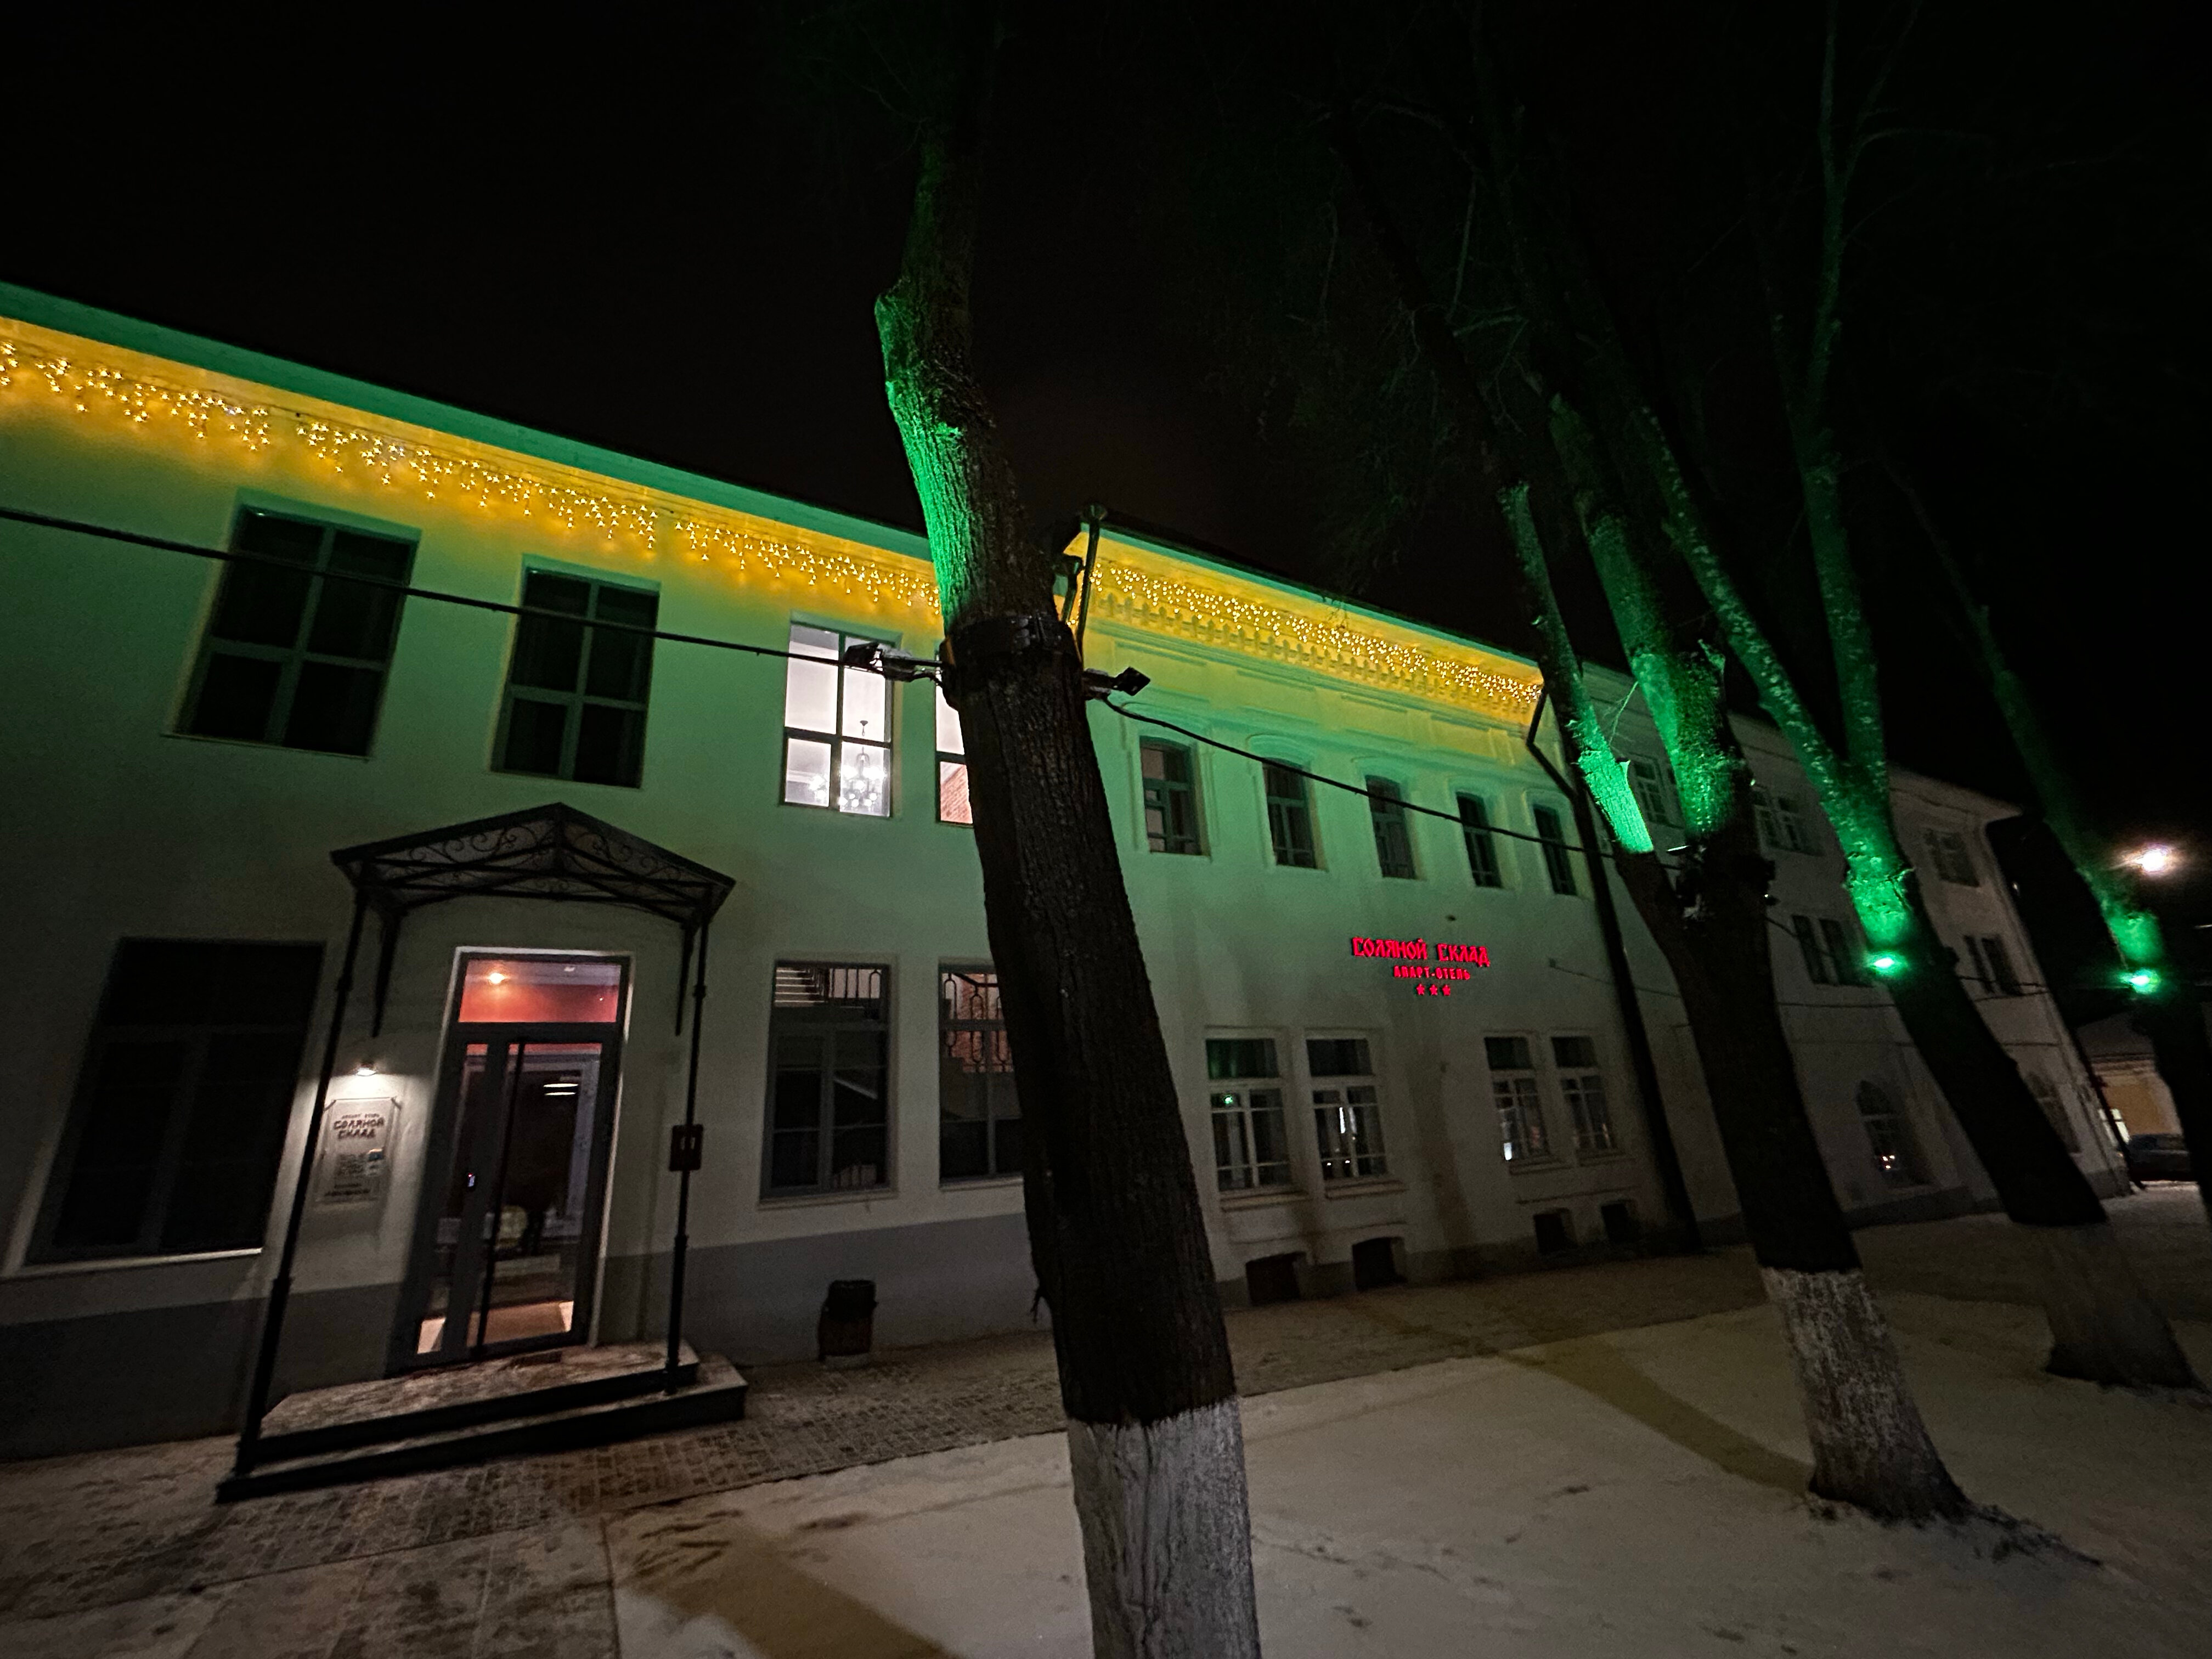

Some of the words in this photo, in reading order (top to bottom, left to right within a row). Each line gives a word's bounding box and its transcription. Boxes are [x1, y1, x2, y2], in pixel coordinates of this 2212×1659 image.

[1352, 936, 1427, 960] СОЛЯНОЙ
[1437, 943, 1490, 967] СКЛАД
[1393, 965, 1470, 980] АПАРТ-ОТЕЛЬ
